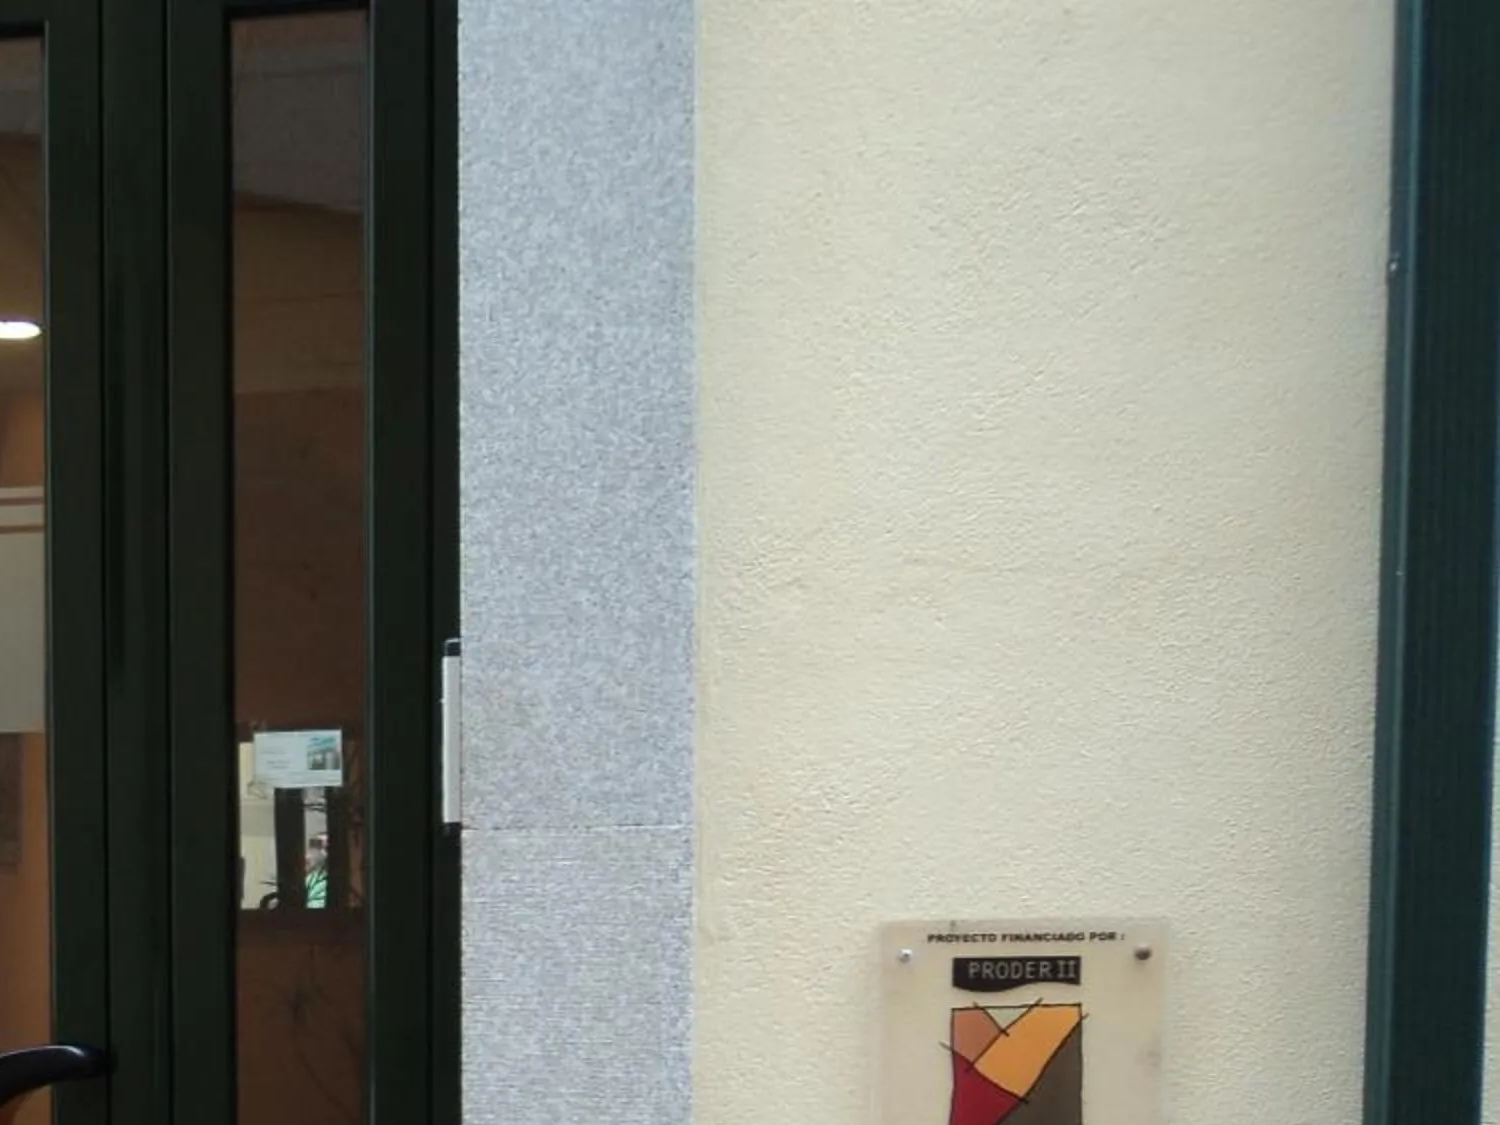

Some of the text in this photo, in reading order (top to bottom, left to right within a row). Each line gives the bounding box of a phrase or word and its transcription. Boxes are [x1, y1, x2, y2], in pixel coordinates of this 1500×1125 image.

[927, 933, 998, 944] PROYECTO
[1001, 932, 1085, 943] FINANCIADO
[1089, 931, 1117, 941] POR
[968, 961, 1051, 980] PRODER
